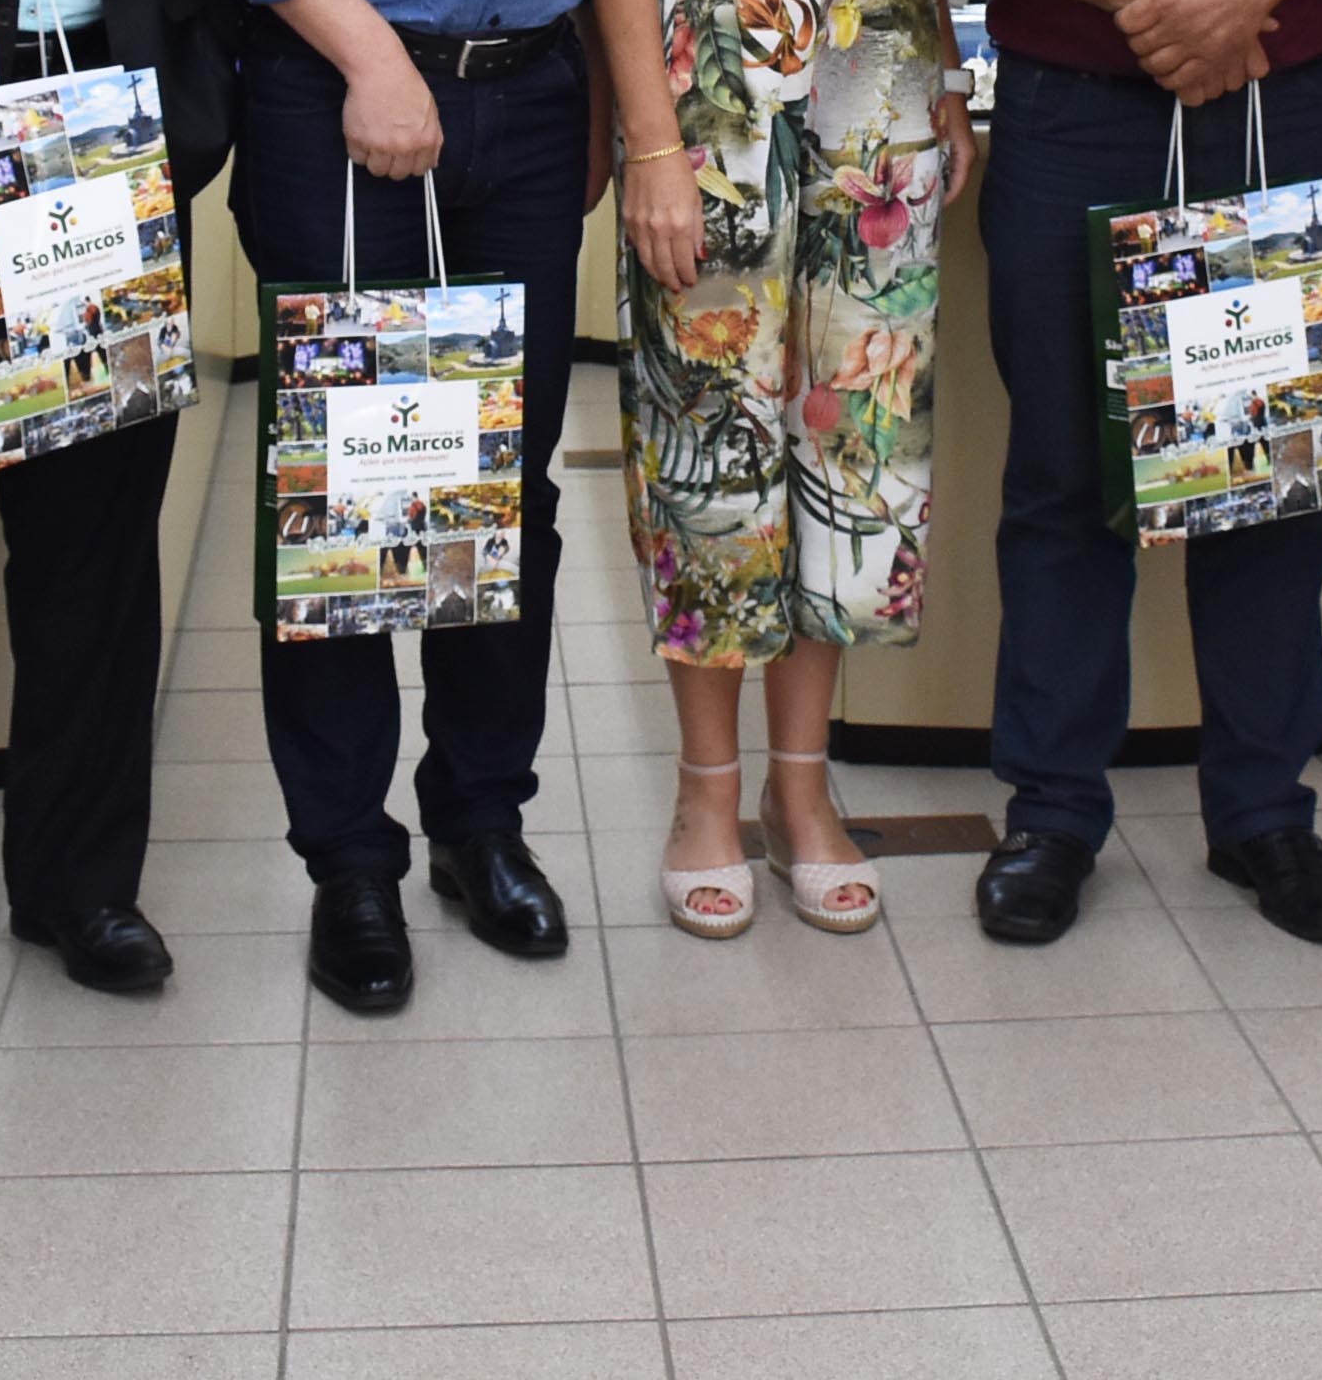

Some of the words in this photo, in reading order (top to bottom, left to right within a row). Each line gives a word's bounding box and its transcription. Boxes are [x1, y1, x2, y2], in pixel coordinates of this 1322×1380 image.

[12, 251, 49, 274] São
[52, 231, 125, 262] Marcos
[1185, 344, 1220, 364] São
[1224, 331, 1293, 356] Marcos
[343, 437, 382, 456] São
[387, 434, 464, 453] Marcos
